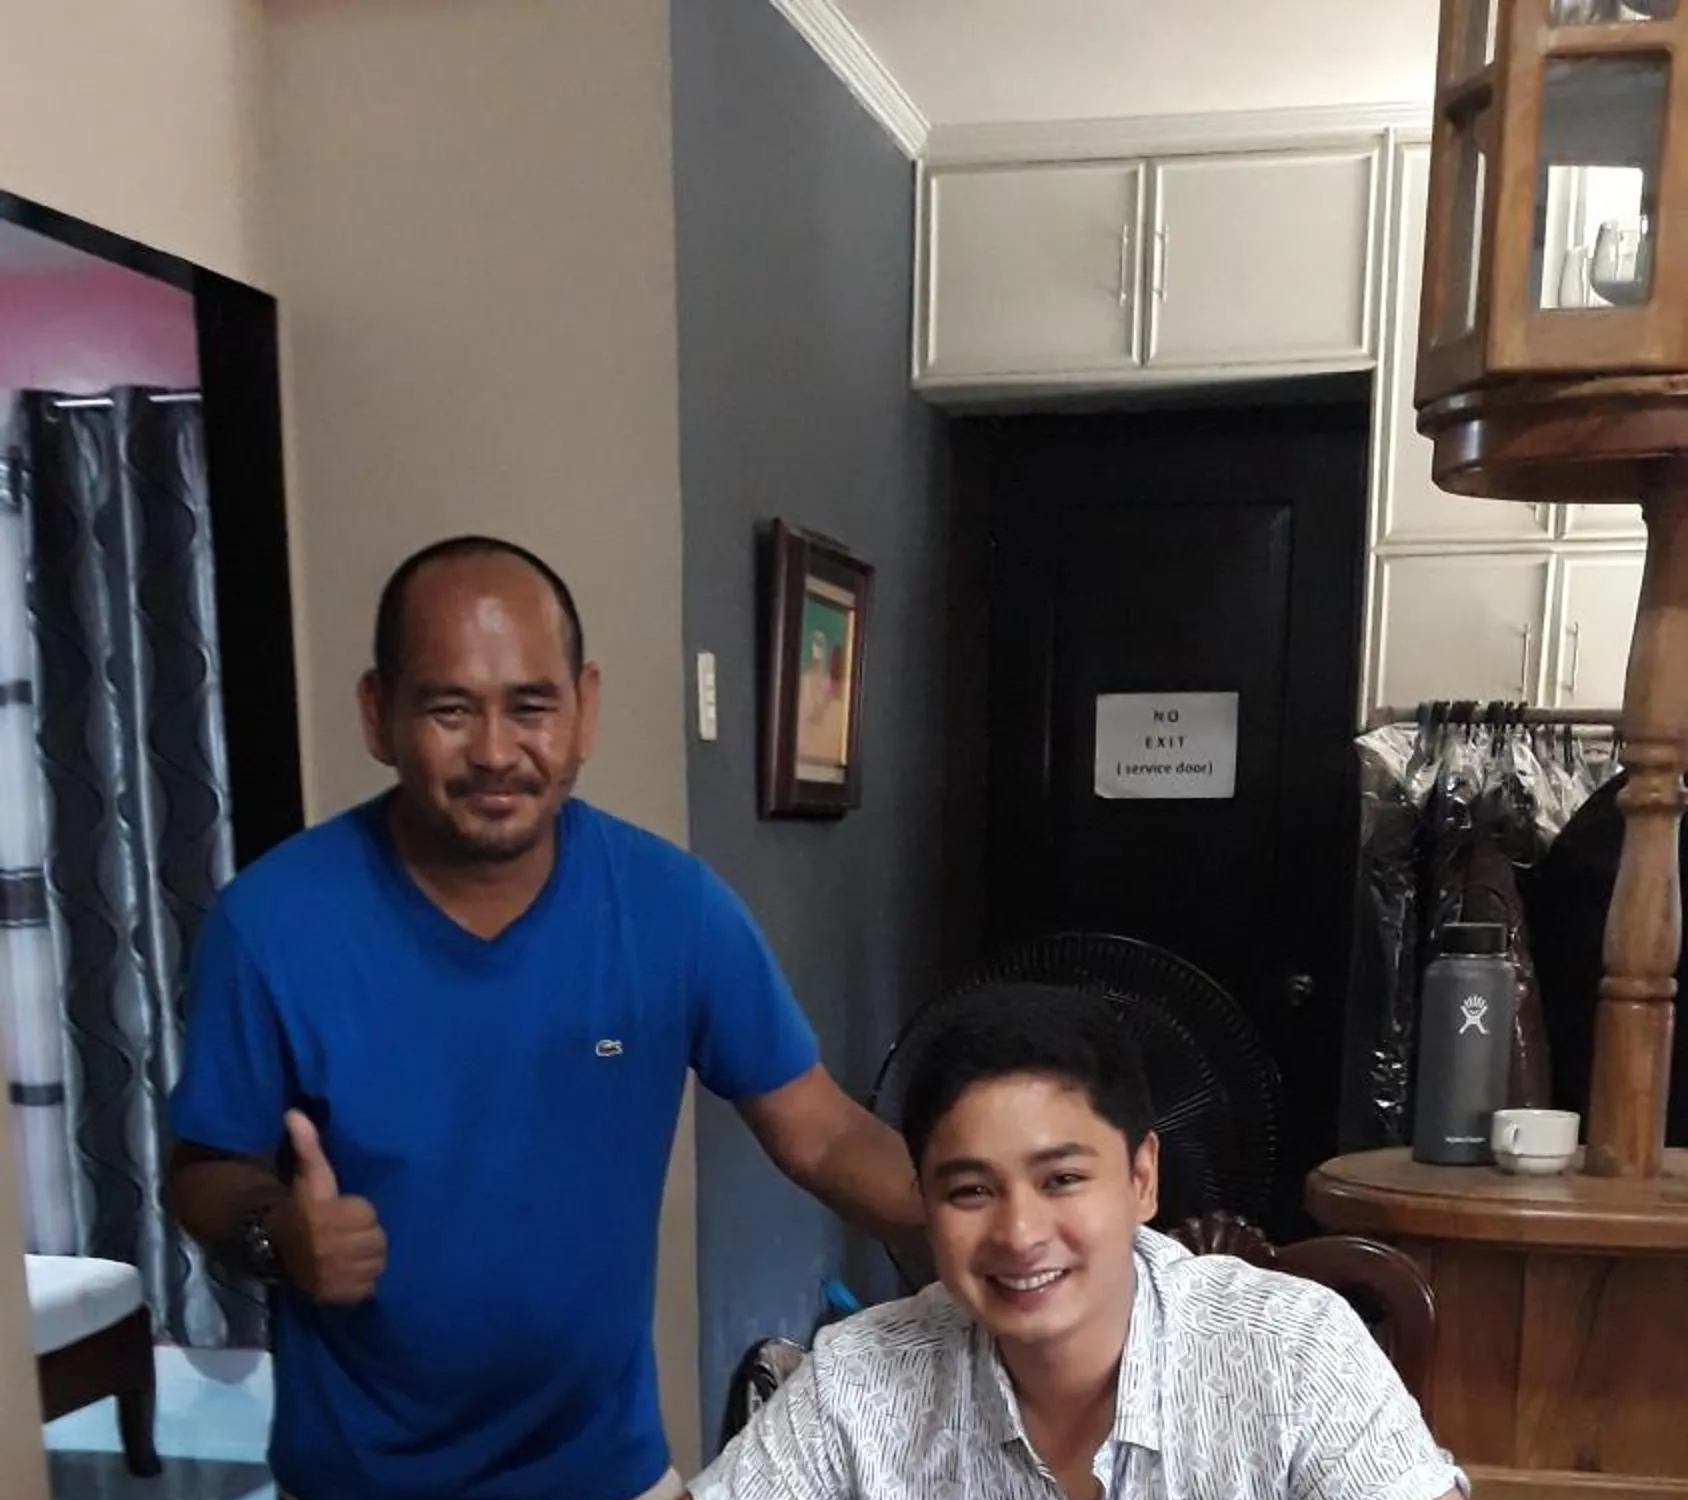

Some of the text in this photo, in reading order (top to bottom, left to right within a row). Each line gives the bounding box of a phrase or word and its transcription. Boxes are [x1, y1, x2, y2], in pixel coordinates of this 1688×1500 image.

[1153, 710, 1179, 723] NO
[1145, 736, 1185, 749] EXIT
[1126, 763, 1172, 775] service
[1175, 761, 1213, 776] door)
